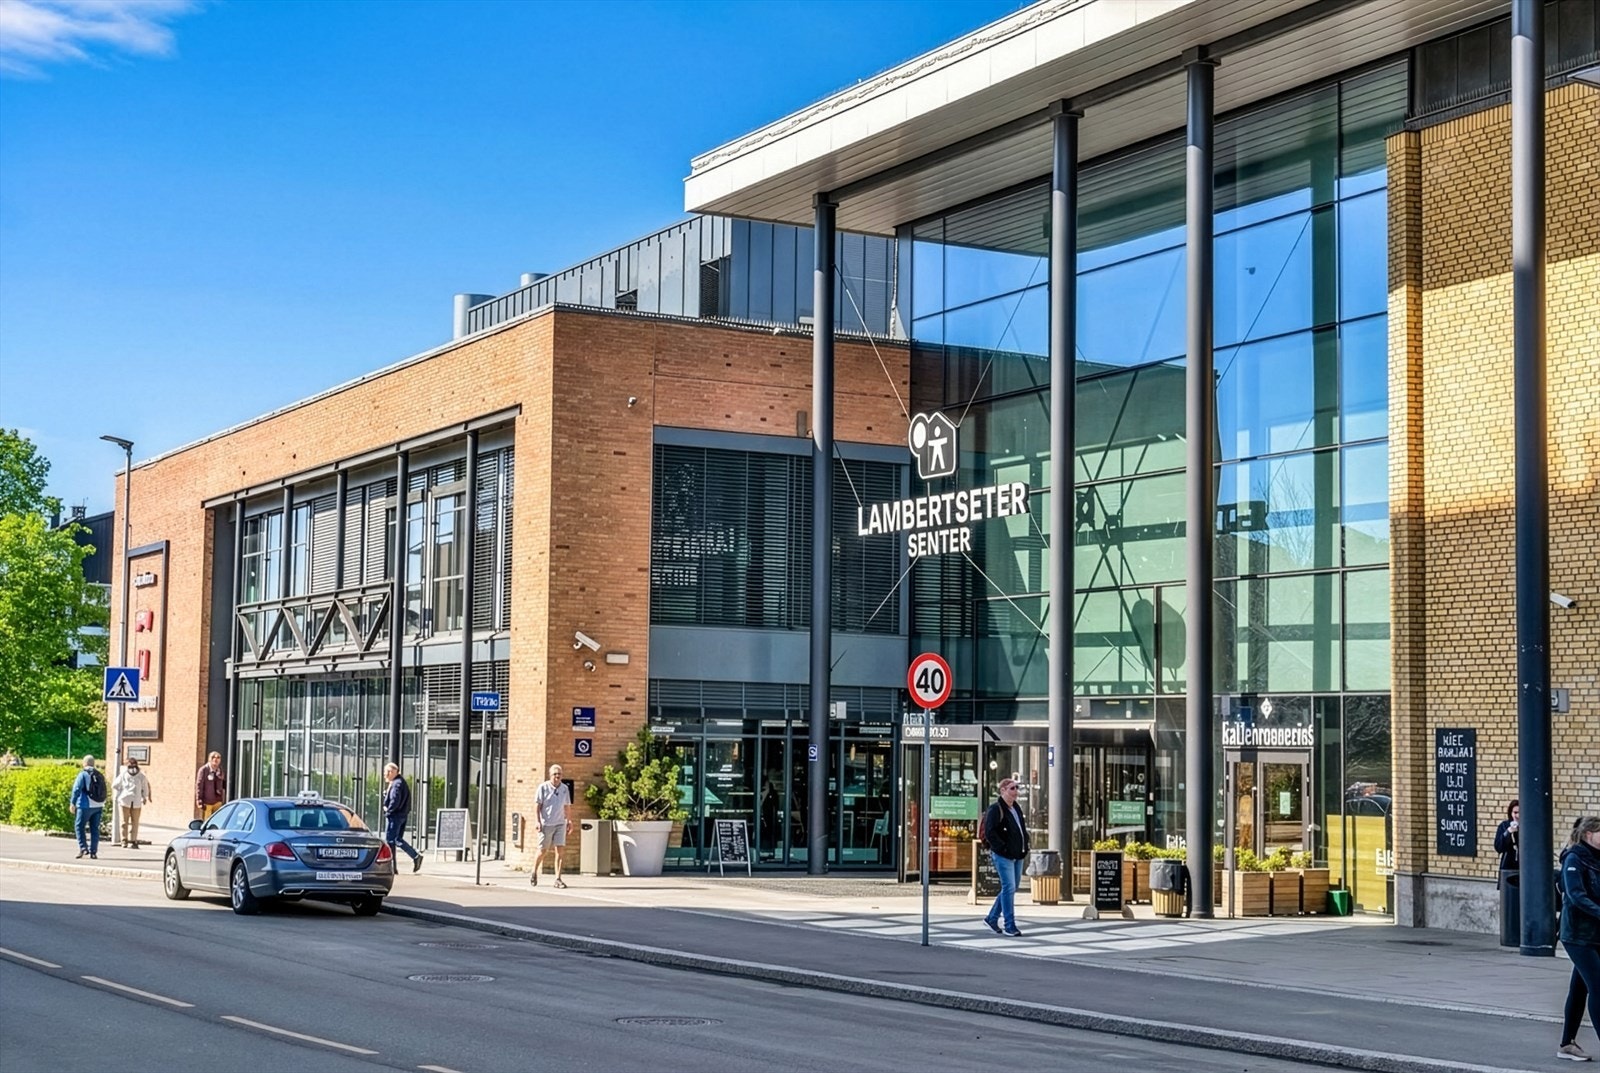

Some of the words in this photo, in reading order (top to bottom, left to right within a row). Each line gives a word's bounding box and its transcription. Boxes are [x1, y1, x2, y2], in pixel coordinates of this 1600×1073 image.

[858, 481, 1028, 536] LAMBERTSETER
[908, 526, 971, 558] SENTER
[916, 668, 945, 695] 40
